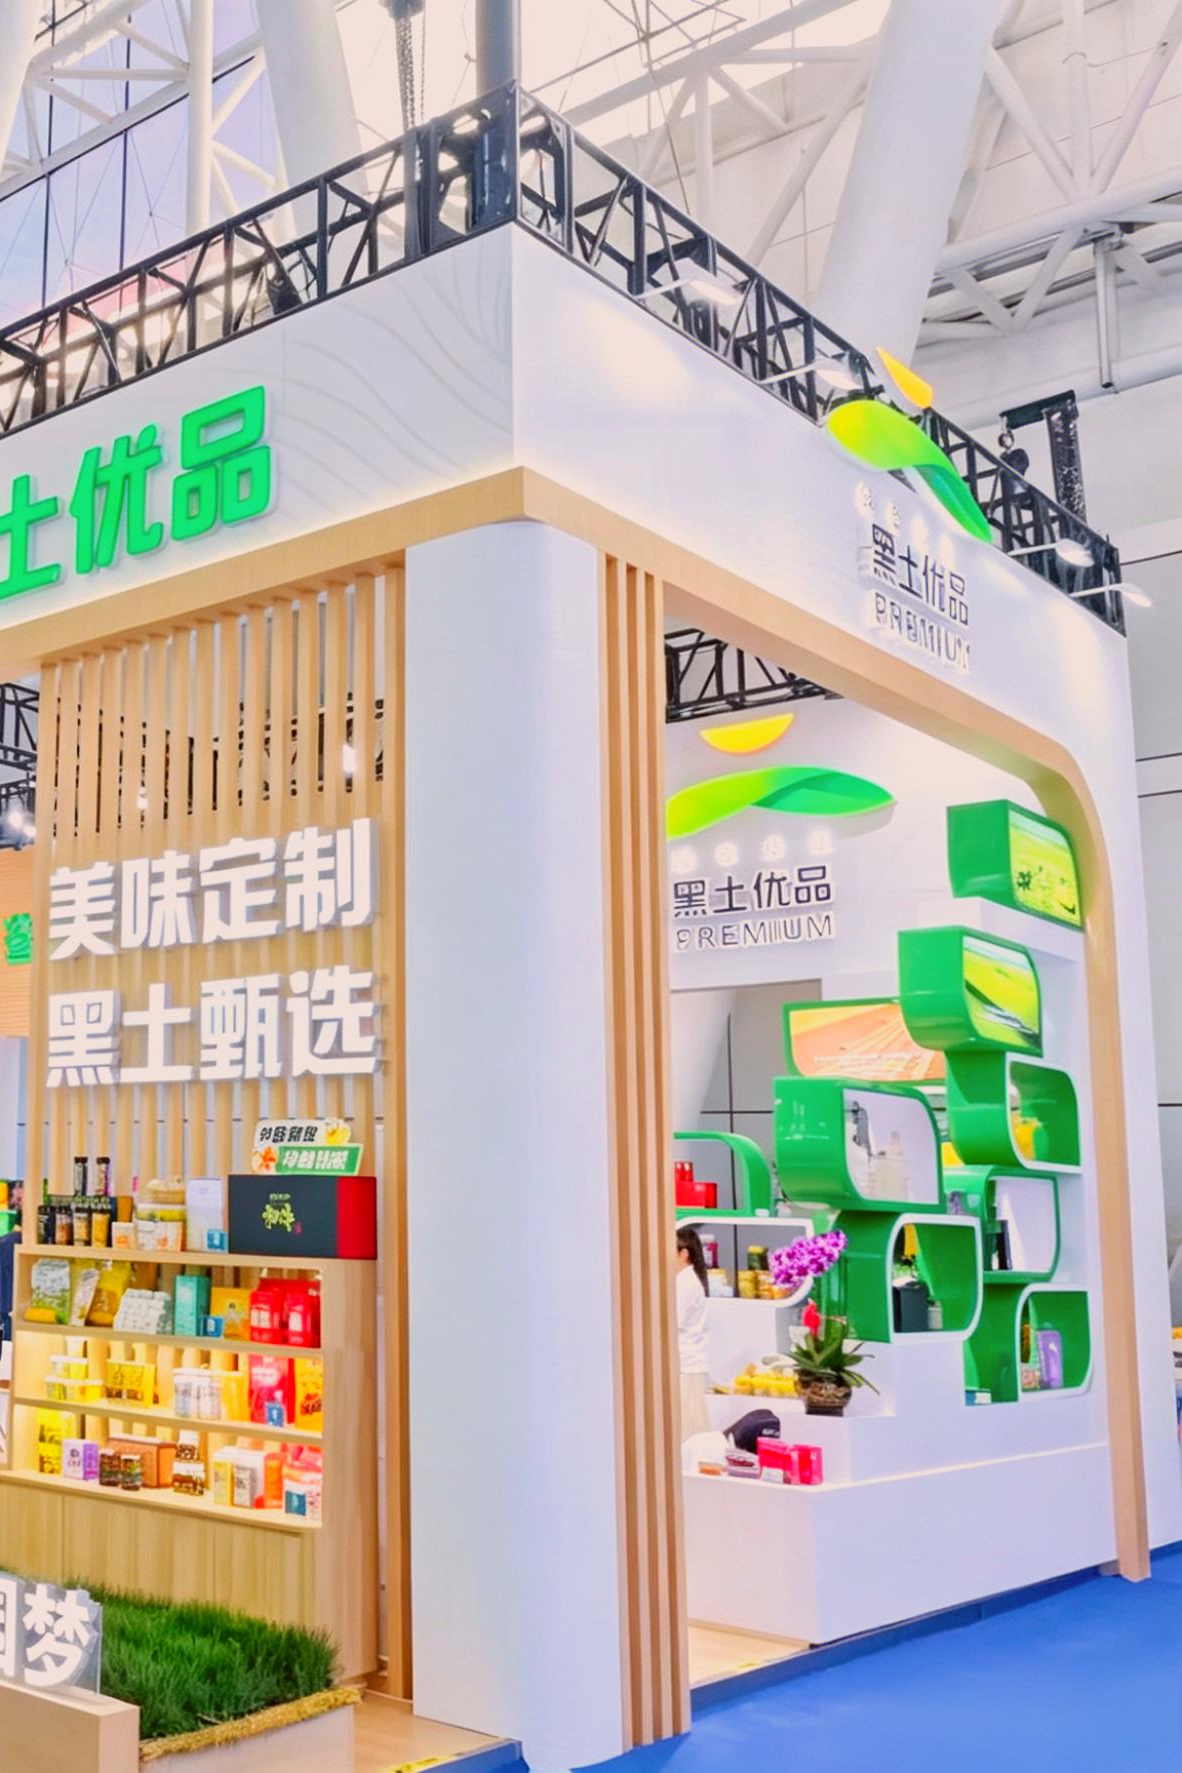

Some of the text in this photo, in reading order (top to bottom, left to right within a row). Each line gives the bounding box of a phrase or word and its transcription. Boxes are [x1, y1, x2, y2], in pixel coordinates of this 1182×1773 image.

[871, 522, 969, 627] 黑土优品
[49, 817, 375, 961] 美味定制
[673, 865, 832, 918] 黑土优品
[46, 965, 378, 1088] 黑土甄选
